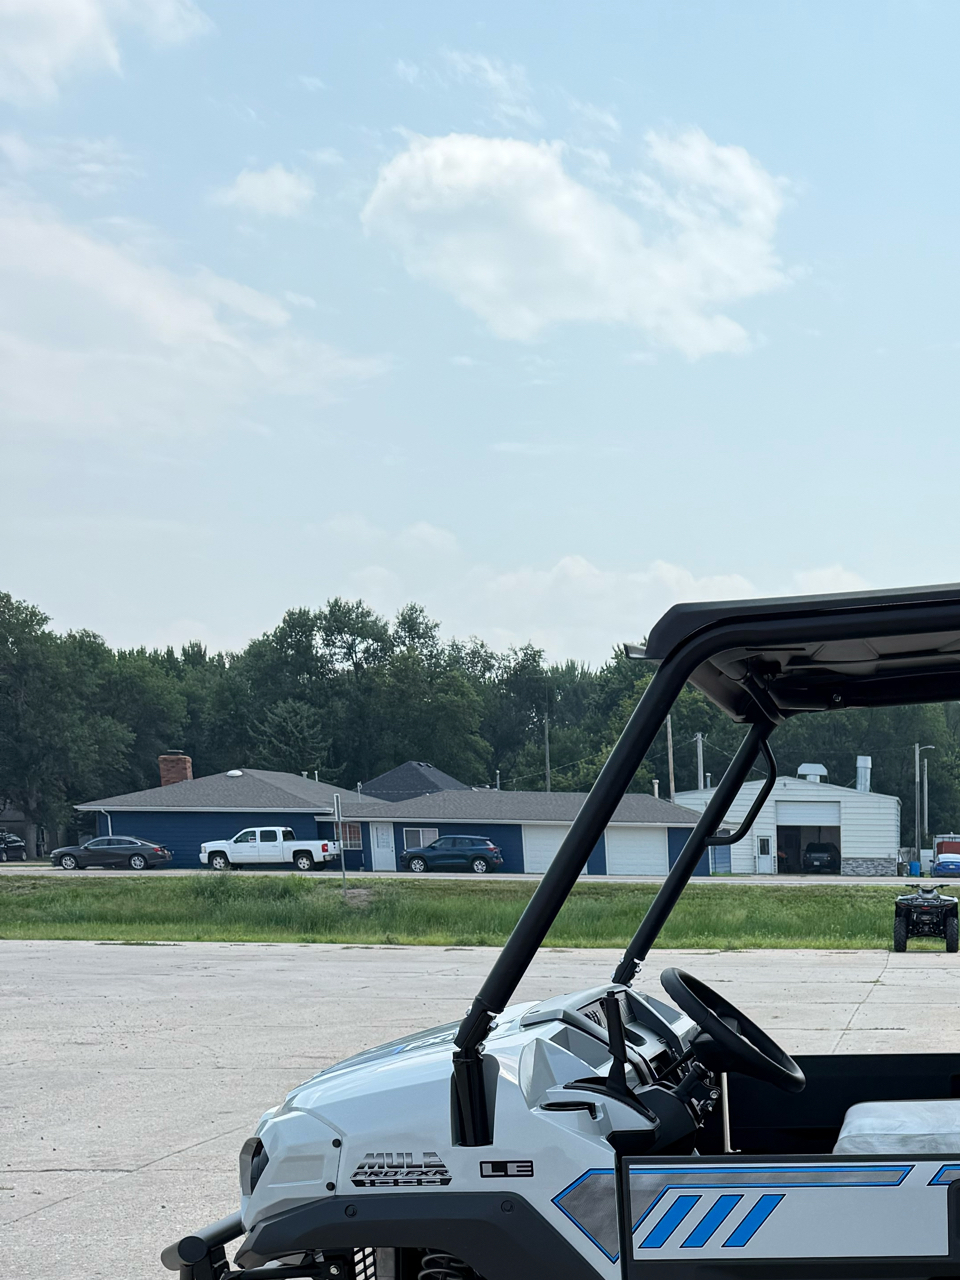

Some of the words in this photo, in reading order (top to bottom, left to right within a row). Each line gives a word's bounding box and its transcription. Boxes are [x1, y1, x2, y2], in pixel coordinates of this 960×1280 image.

[357, 1152, 447, 1169] MULE
[482, 1162, 532, 1176] LE
[363, 1178, 441, 1187] 1000
